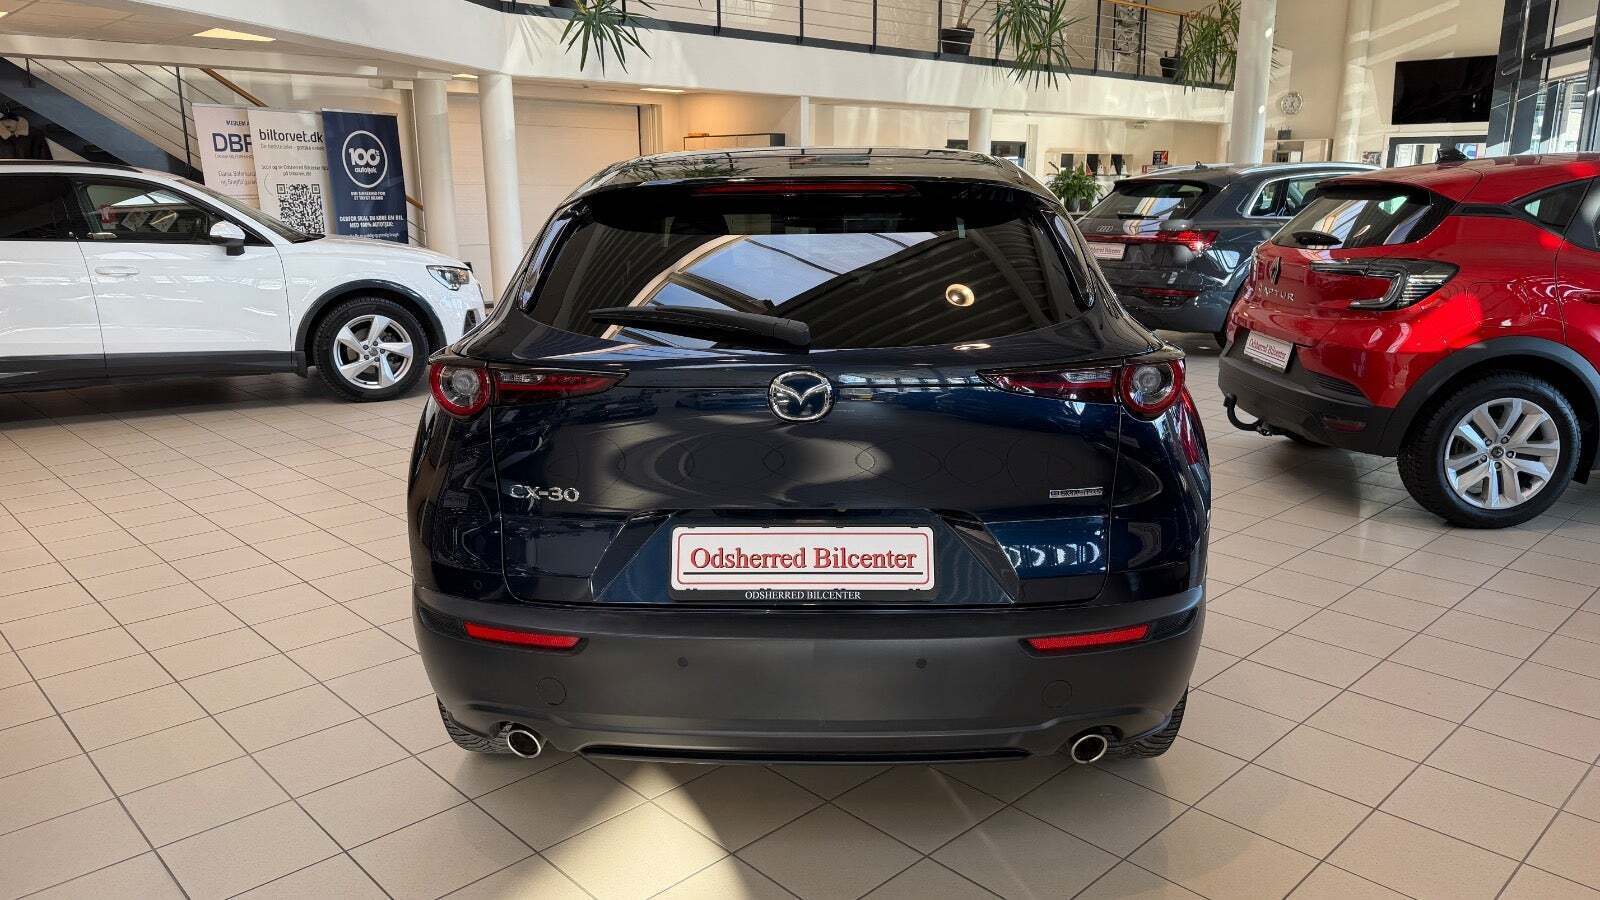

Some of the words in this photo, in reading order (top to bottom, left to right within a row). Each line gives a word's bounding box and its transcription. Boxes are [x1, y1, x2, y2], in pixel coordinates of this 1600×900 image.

[259, 129, 324, 143] biltorvet.dk
[510, 484, 580, 507] CX-30
[690, 547, 807, 569] Odsherred
[813, 547, 917, 569] Bilcenter
[745, 590, 804, 600] ODSHERRED
[806, 590, 862, 600] BILCENTER
